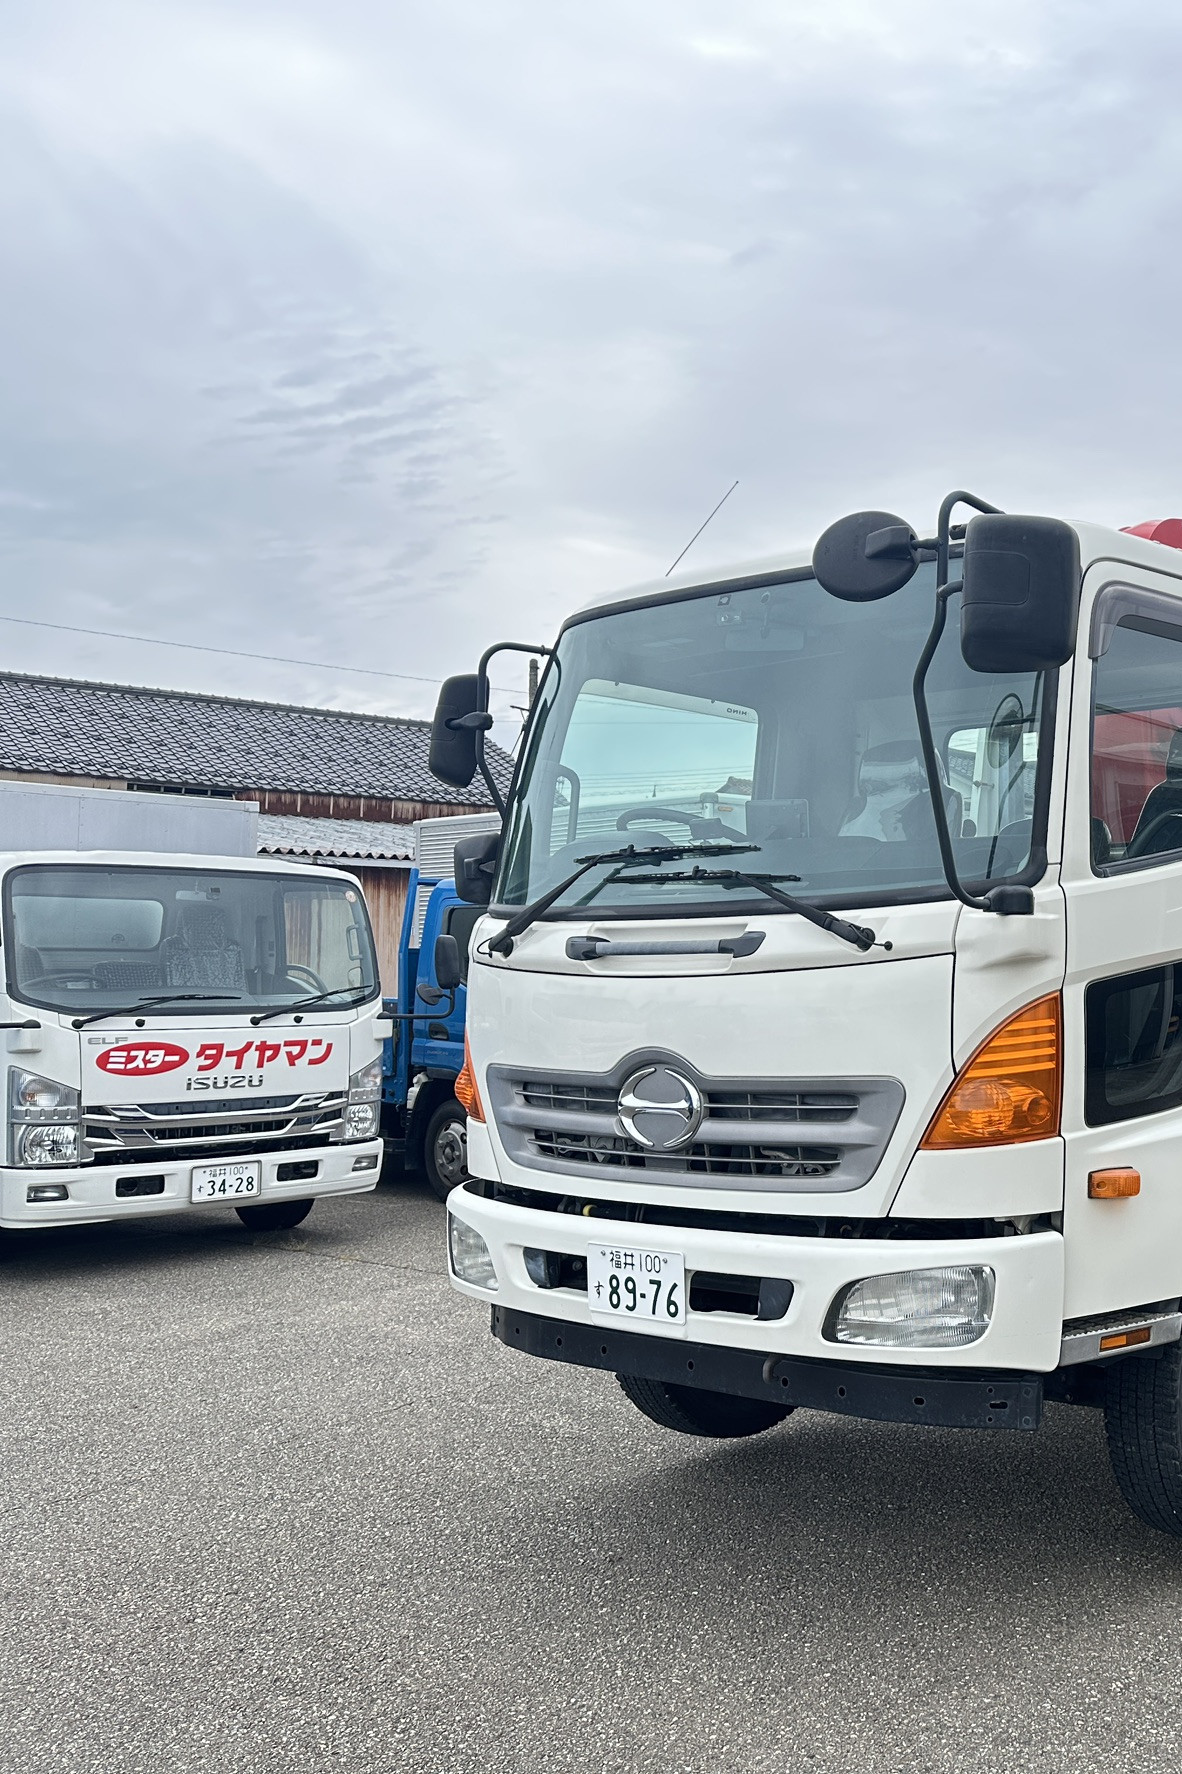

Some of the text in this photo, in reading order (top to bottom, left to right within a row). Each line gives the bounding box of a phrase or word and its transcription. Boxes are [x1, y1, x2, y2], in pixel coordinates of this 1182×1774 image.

[87, 1037, 128, 1045] ELF
[106, 1038, 333, 1072] ミスター タイヤマン
[207, 1176, 254, 1196] 34-28
[593, 1273, 679, 1318] す 89-76
